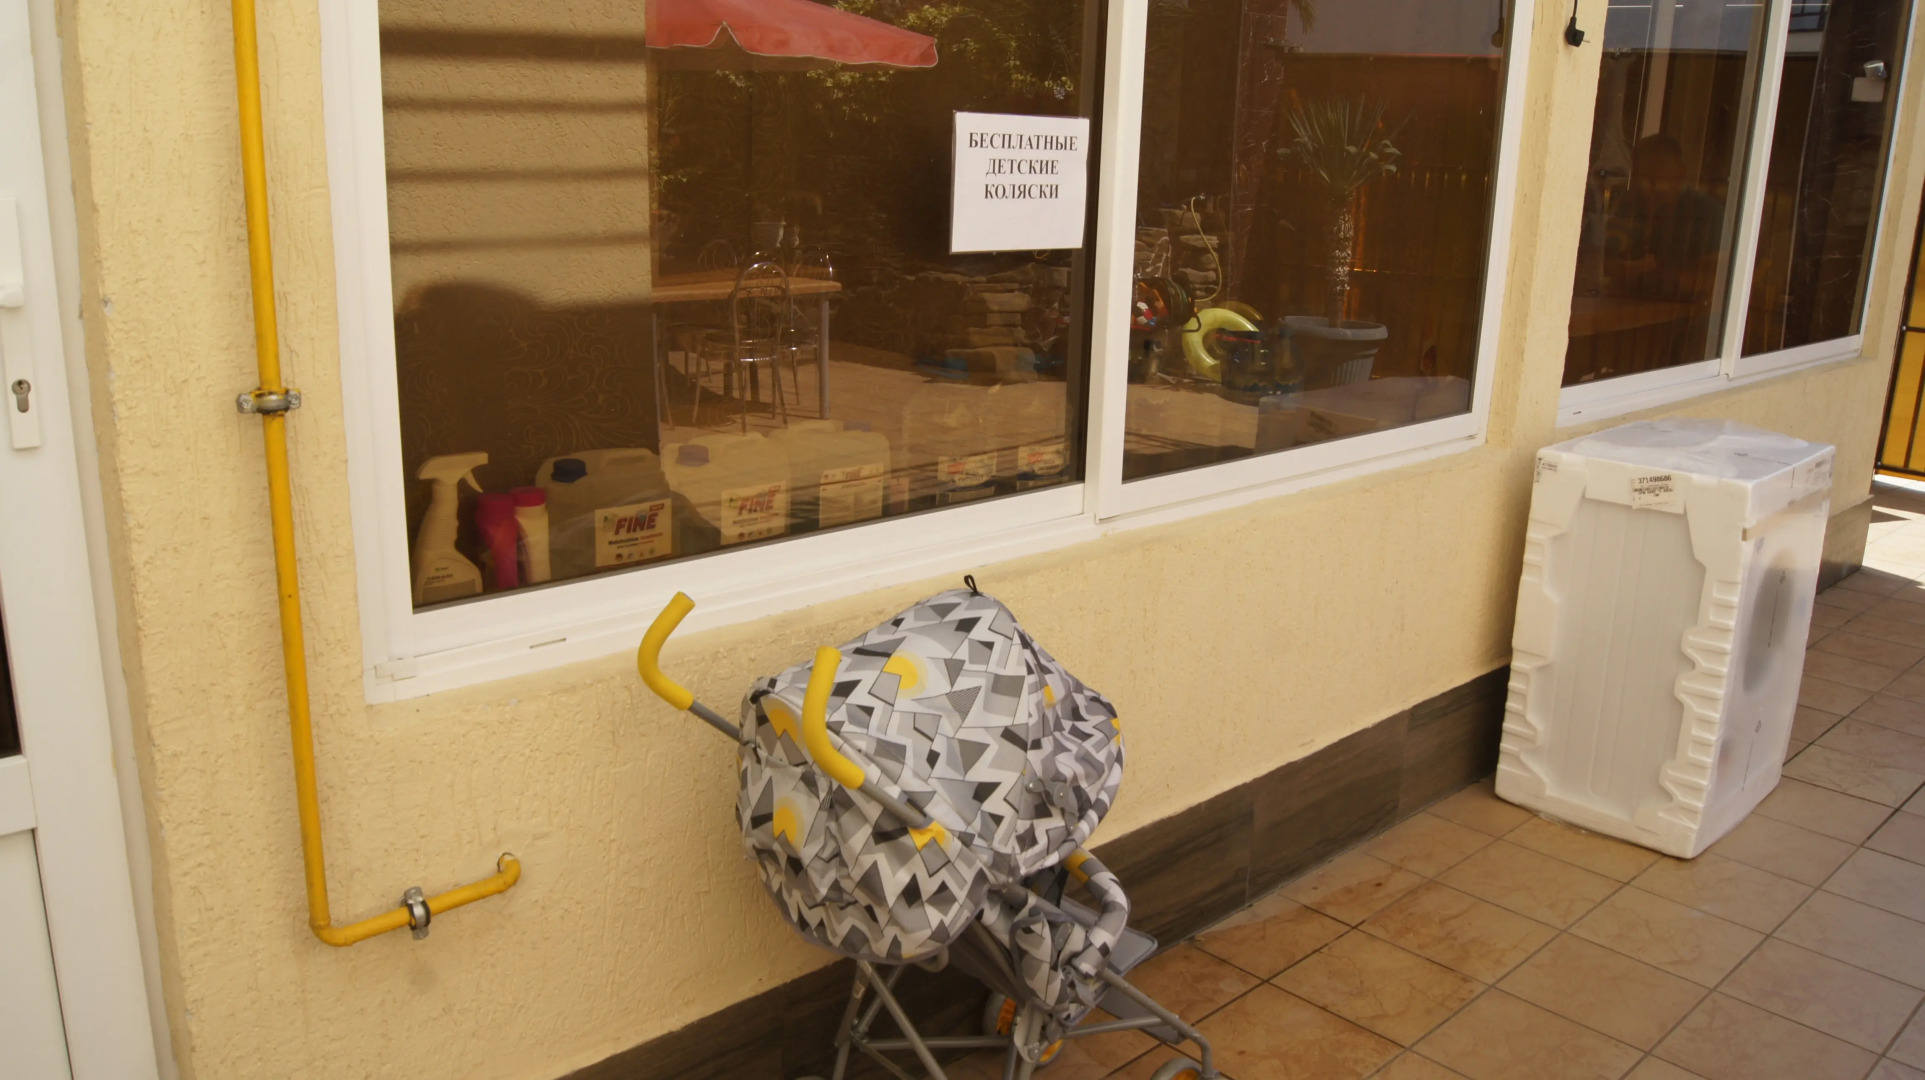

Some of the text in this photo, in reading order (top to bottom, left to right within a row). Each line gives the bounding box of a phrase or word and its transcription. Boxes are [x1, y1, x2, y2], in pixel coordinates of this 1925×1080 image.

[968, 132, 1078, 151] БЕСПЛАТНЫЕ
[985, 158, 1059, 177] ДЕТСКИЕ
[984, 183, 1059, 200] КОЛЯСКИ
[614, 512, 658, 535] FINE
